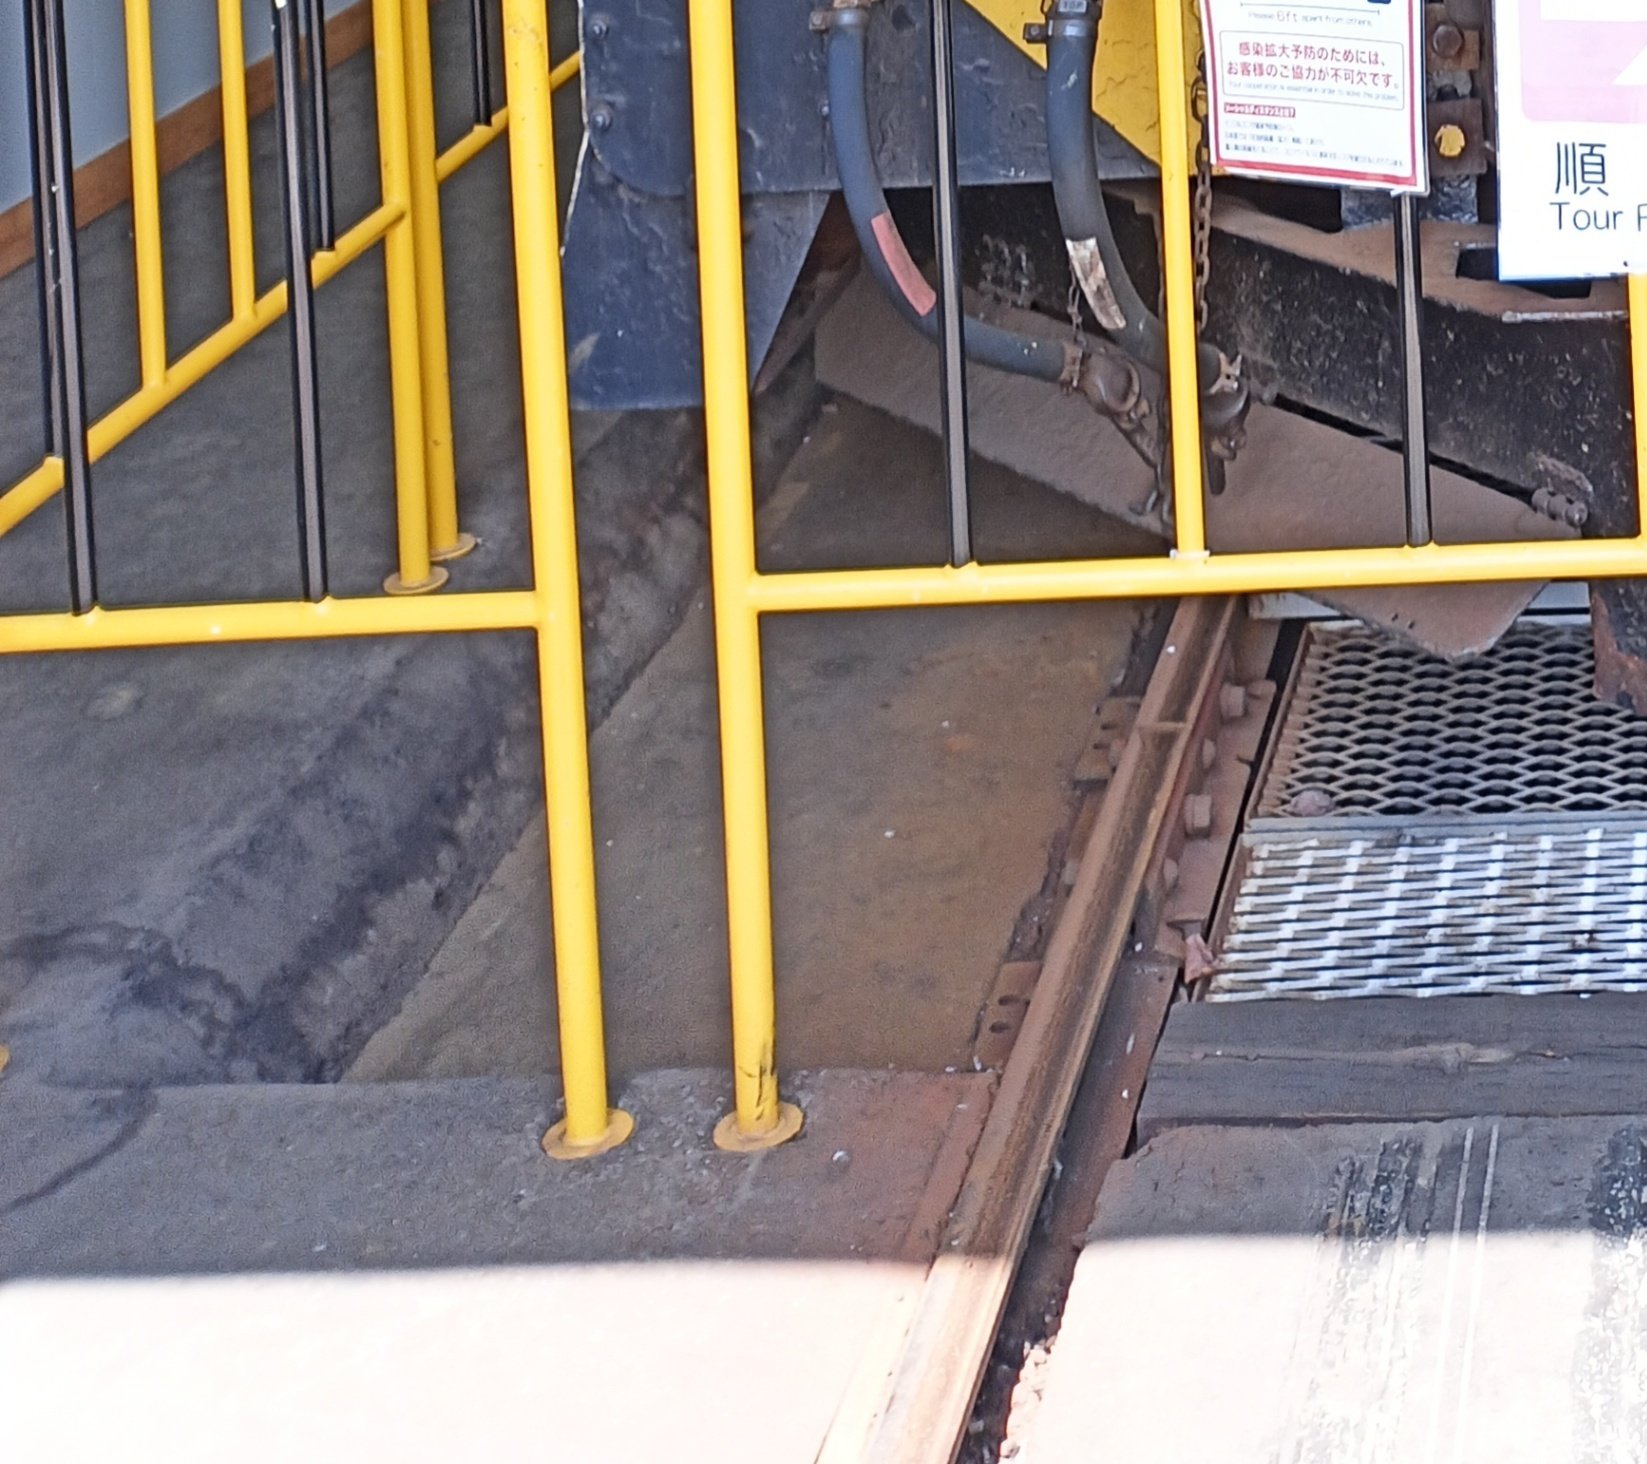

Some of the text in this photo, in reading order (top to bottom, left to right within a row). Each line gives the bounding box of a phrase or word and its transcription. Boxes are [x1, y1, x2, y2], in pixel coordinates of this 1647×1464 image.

[1239, 42, 1385, 67] 感染拡大予防のためには、
[1227, 62, 1399, 89] お客様のご協力が不可欠です。
[1549, 202, 1623, 230] Tour
